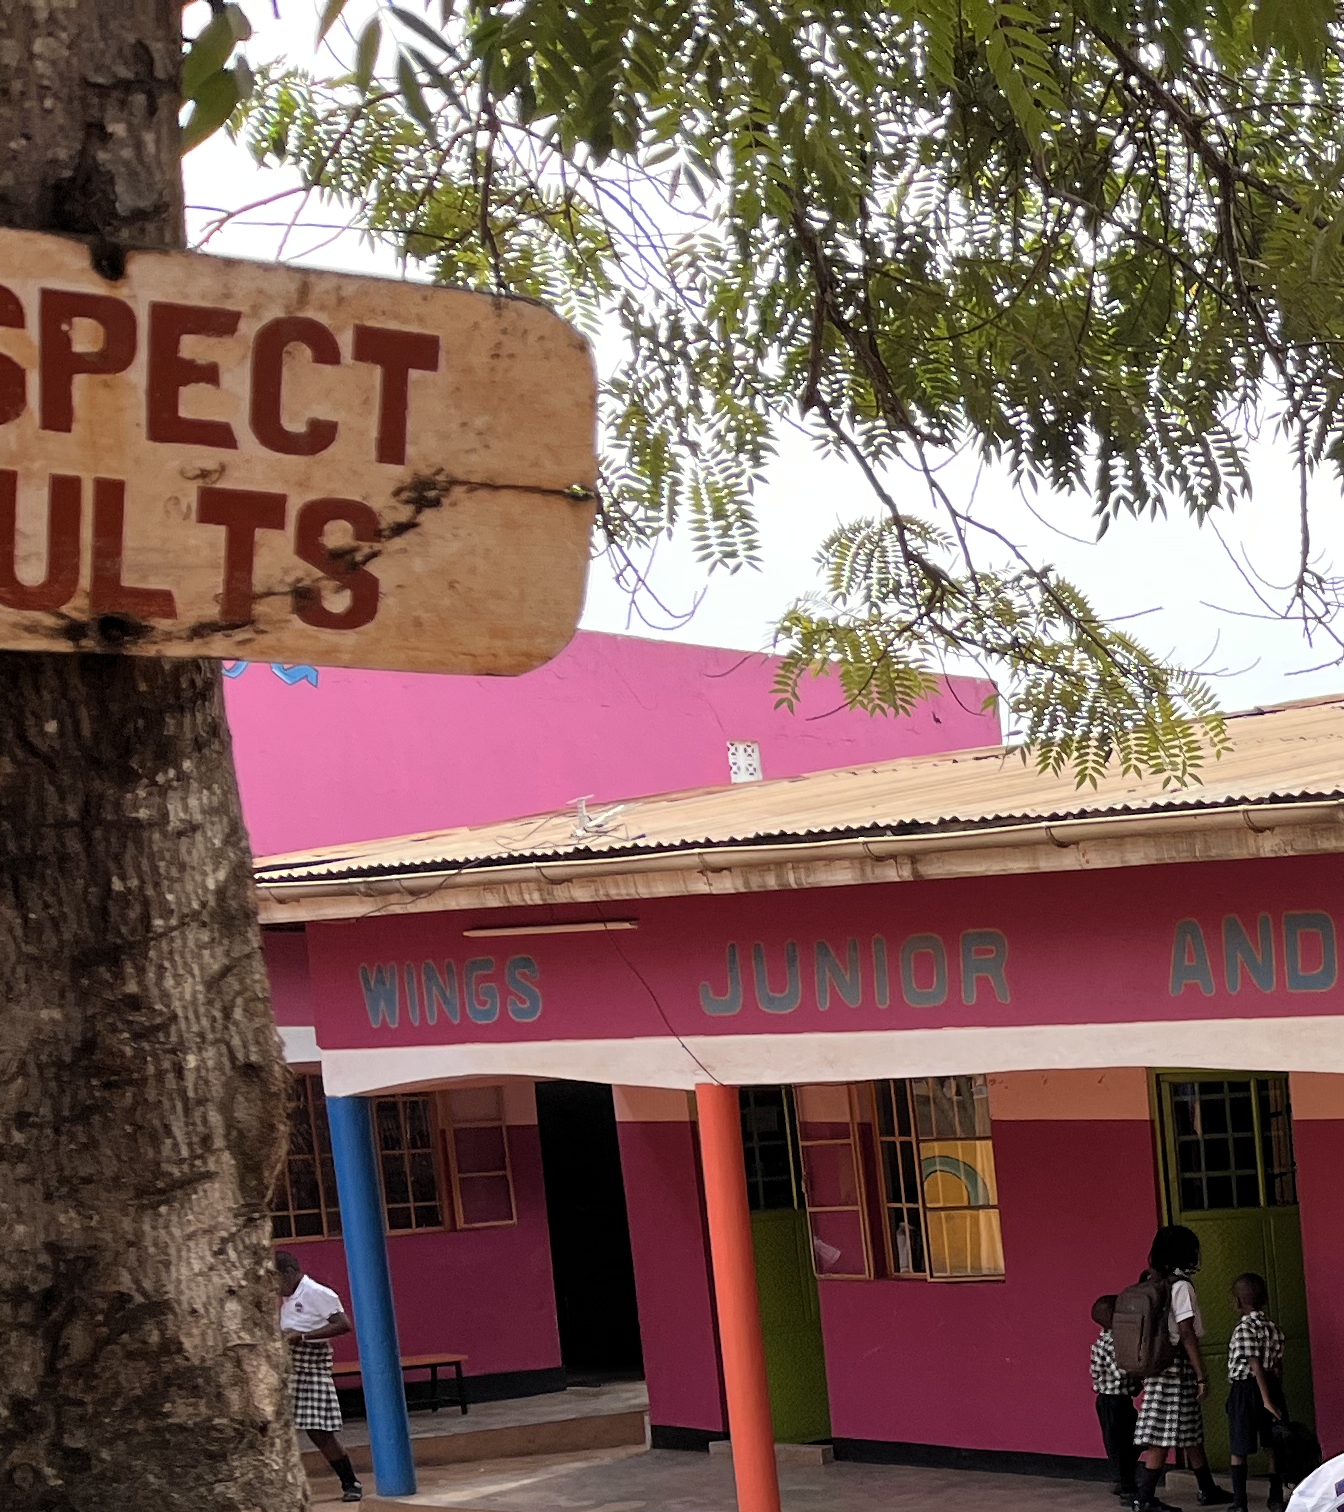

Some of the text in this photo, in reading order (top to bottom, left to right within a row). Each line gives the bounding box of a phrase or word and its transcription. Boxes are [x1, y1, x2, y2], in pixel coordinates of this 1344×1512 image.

[359, 955, 542, 1029] WINGS
[699, 928, 1011, 1016] JUNIOR
[1169, 910, 1338, 996] AND
